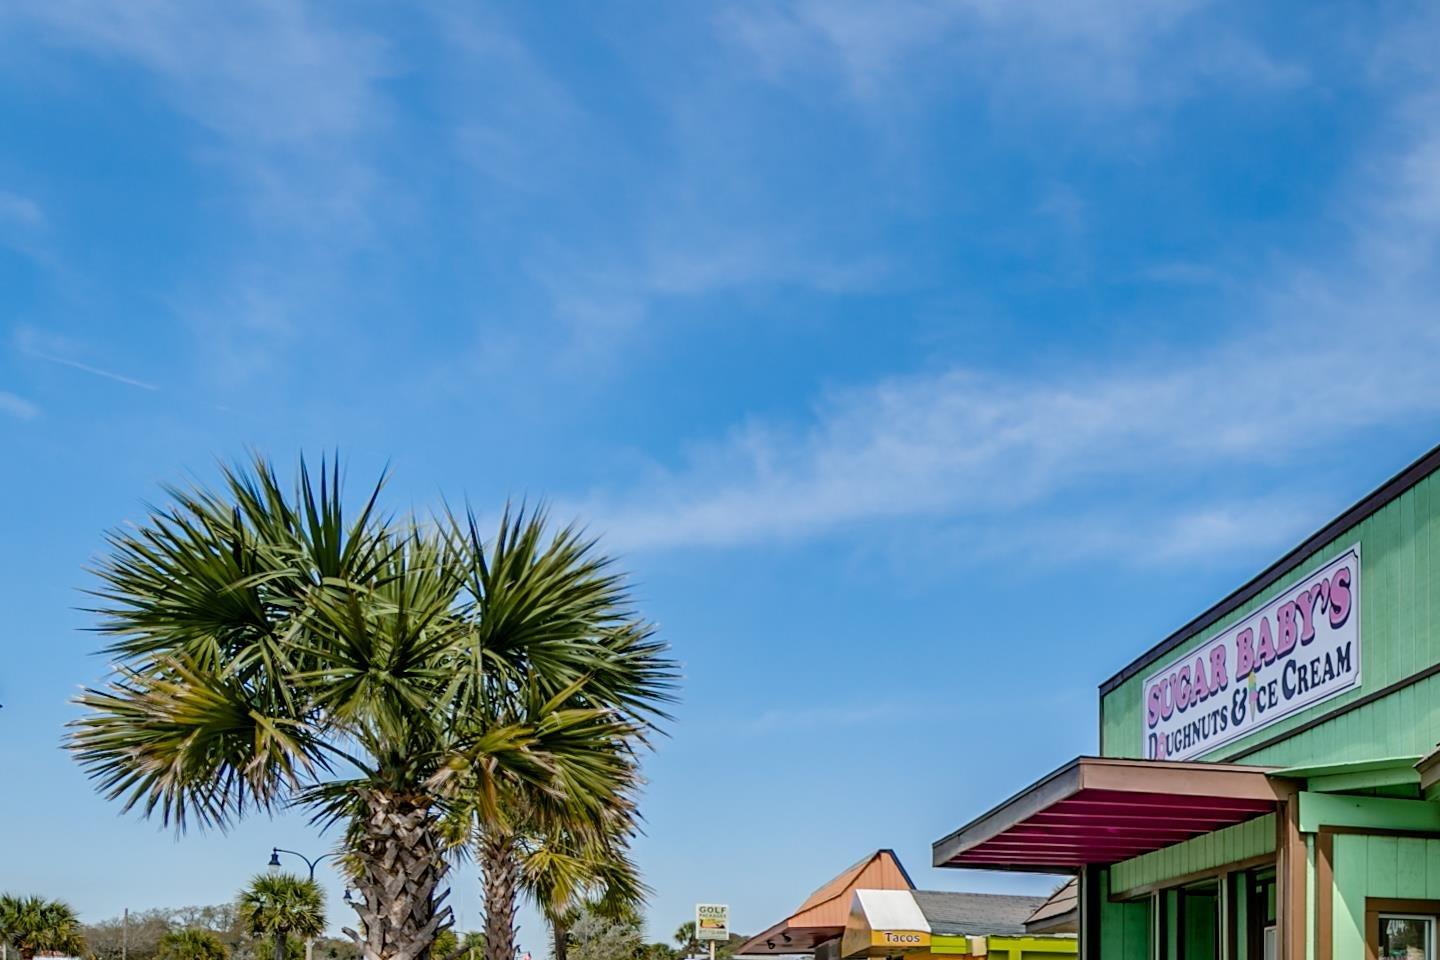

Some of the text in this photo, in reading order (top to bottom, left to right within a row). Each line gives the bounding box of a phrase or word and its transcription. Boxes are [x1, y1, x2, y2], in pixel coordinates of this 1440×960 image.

[1147, 566, 1351, 729] SUGAR BABY'S
[1231, 687, 1248, 726] &
[1281, 641, 1352, 700] CREAM
[884, 932, 920, 943] Tacos
